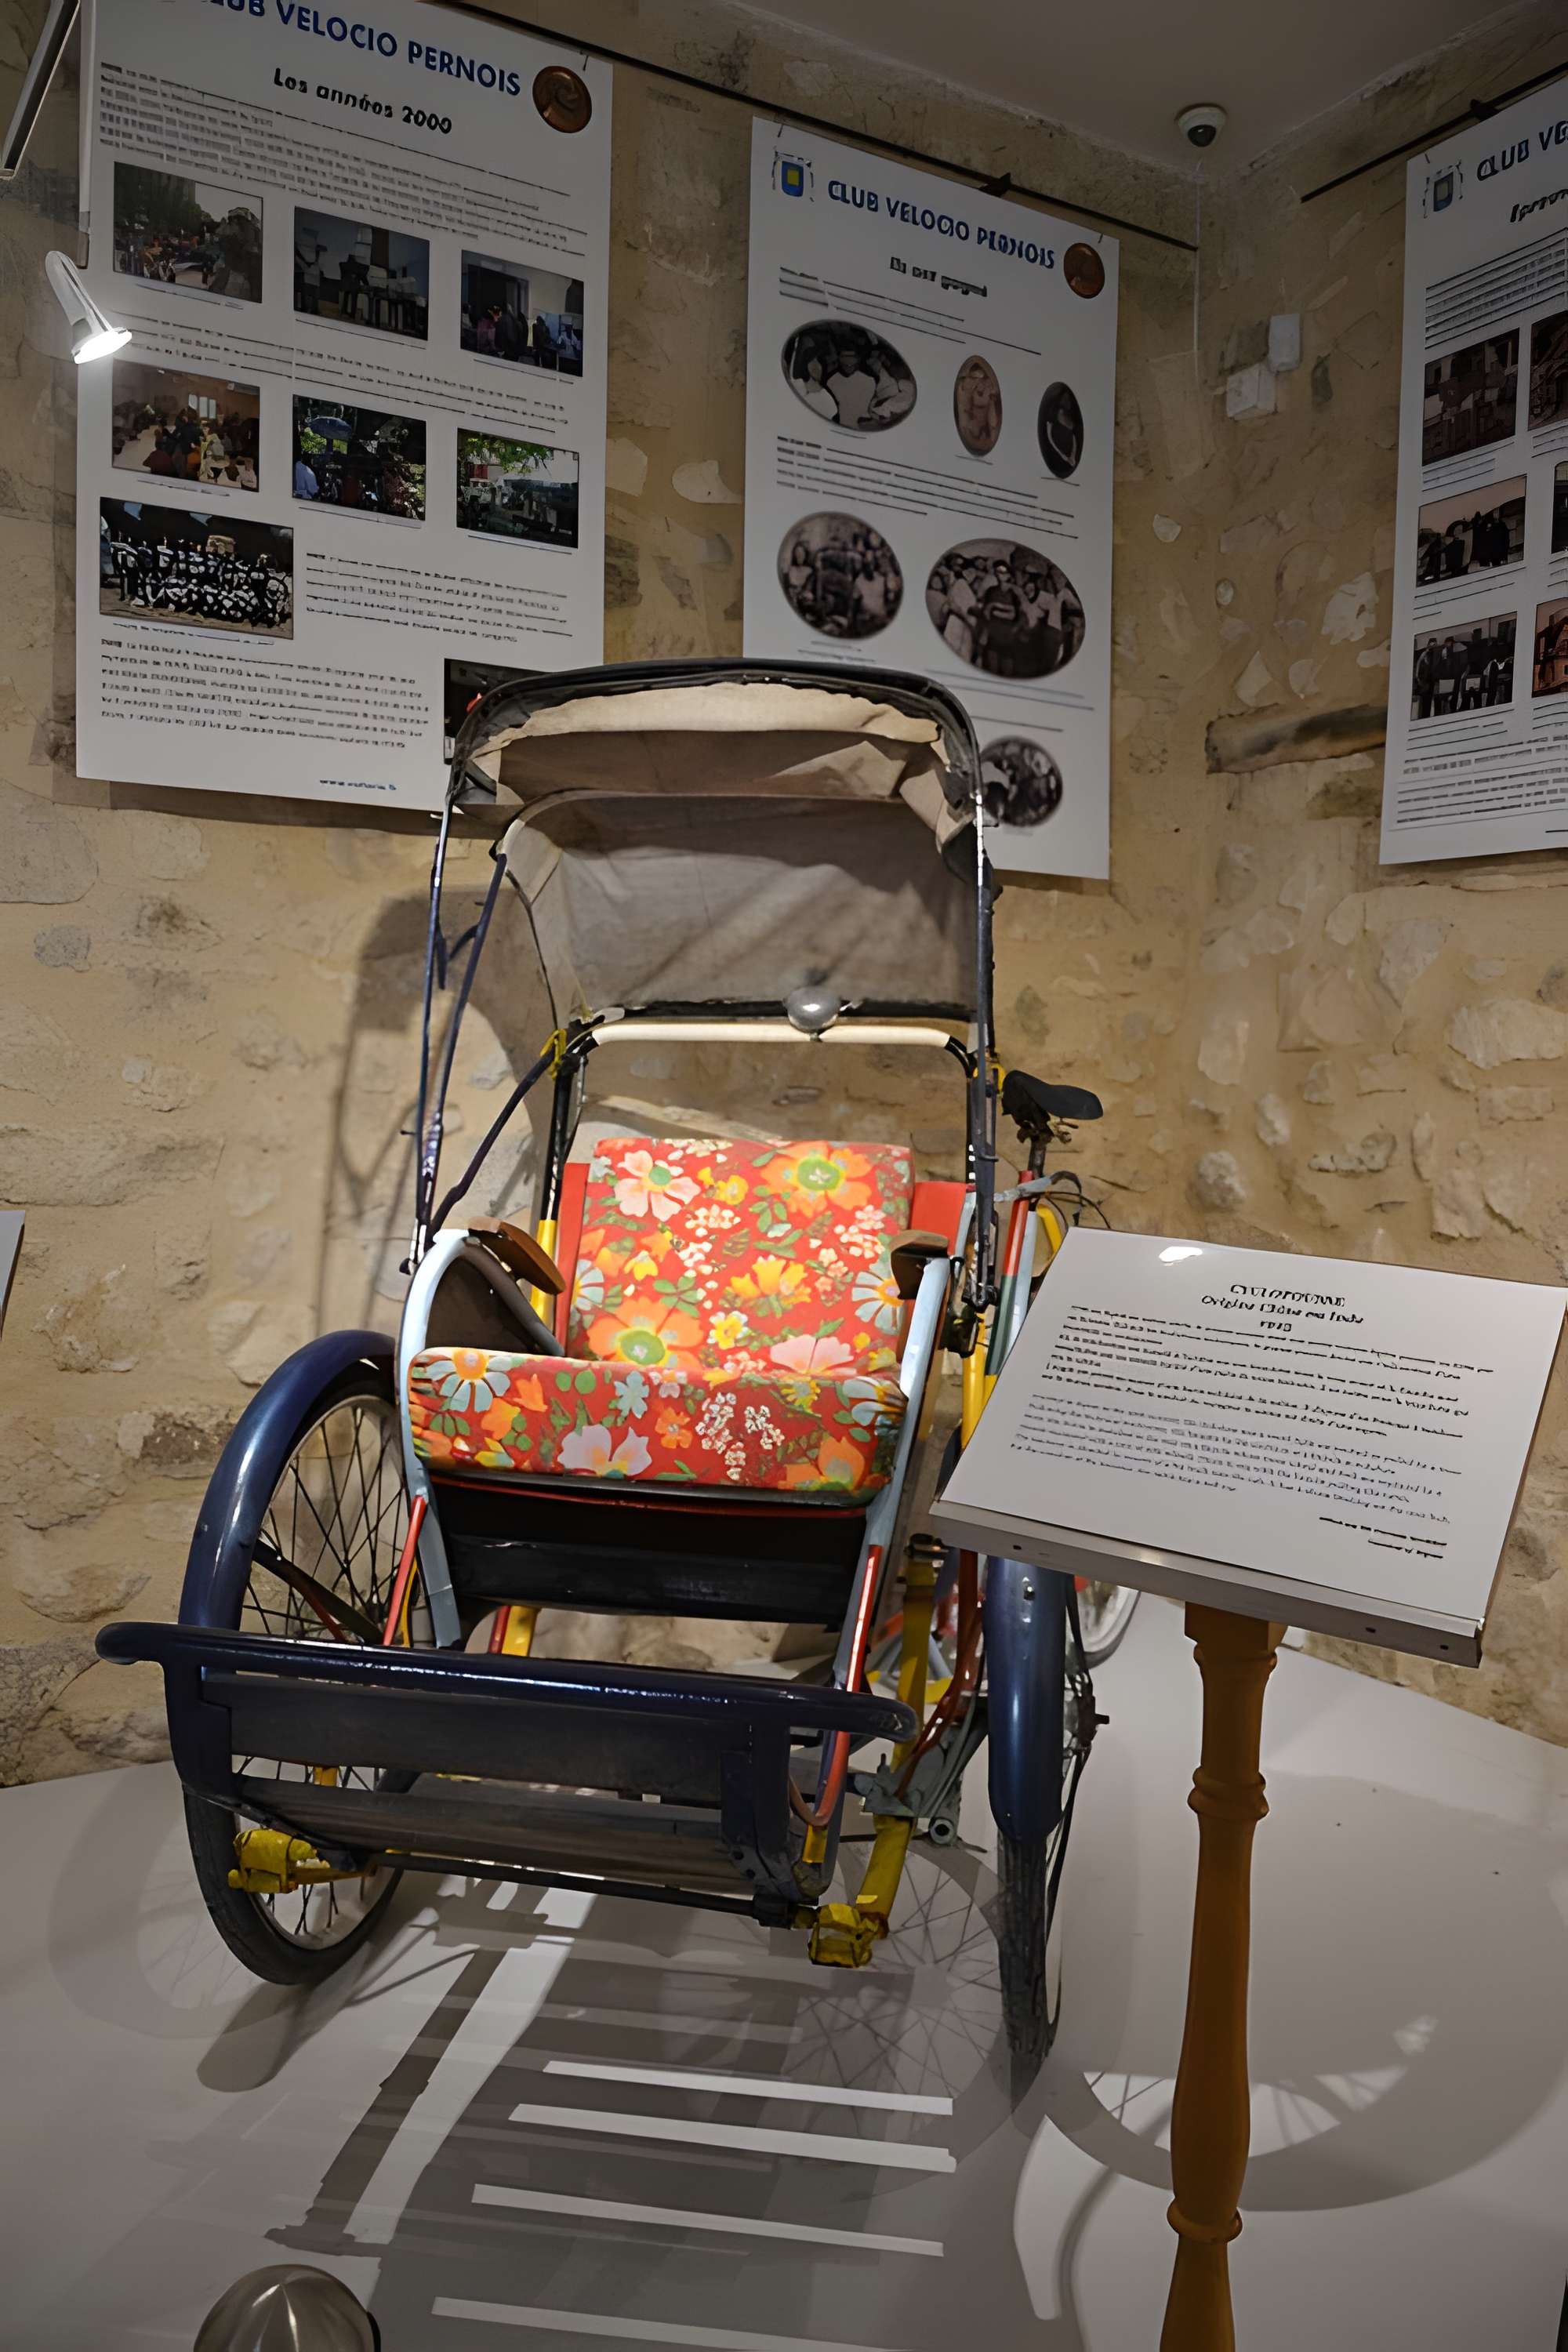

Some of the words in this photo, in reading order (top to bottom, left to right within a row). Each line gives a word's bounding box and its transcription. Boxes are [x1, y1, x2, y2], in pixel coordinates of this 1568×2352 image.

[277, 0, 397, 57] VELOCIO
[408, 41, 521, 96] PERNOIS
[402, 106, 452, 133] 2000
[828, 180, 879, 212] CLUB
